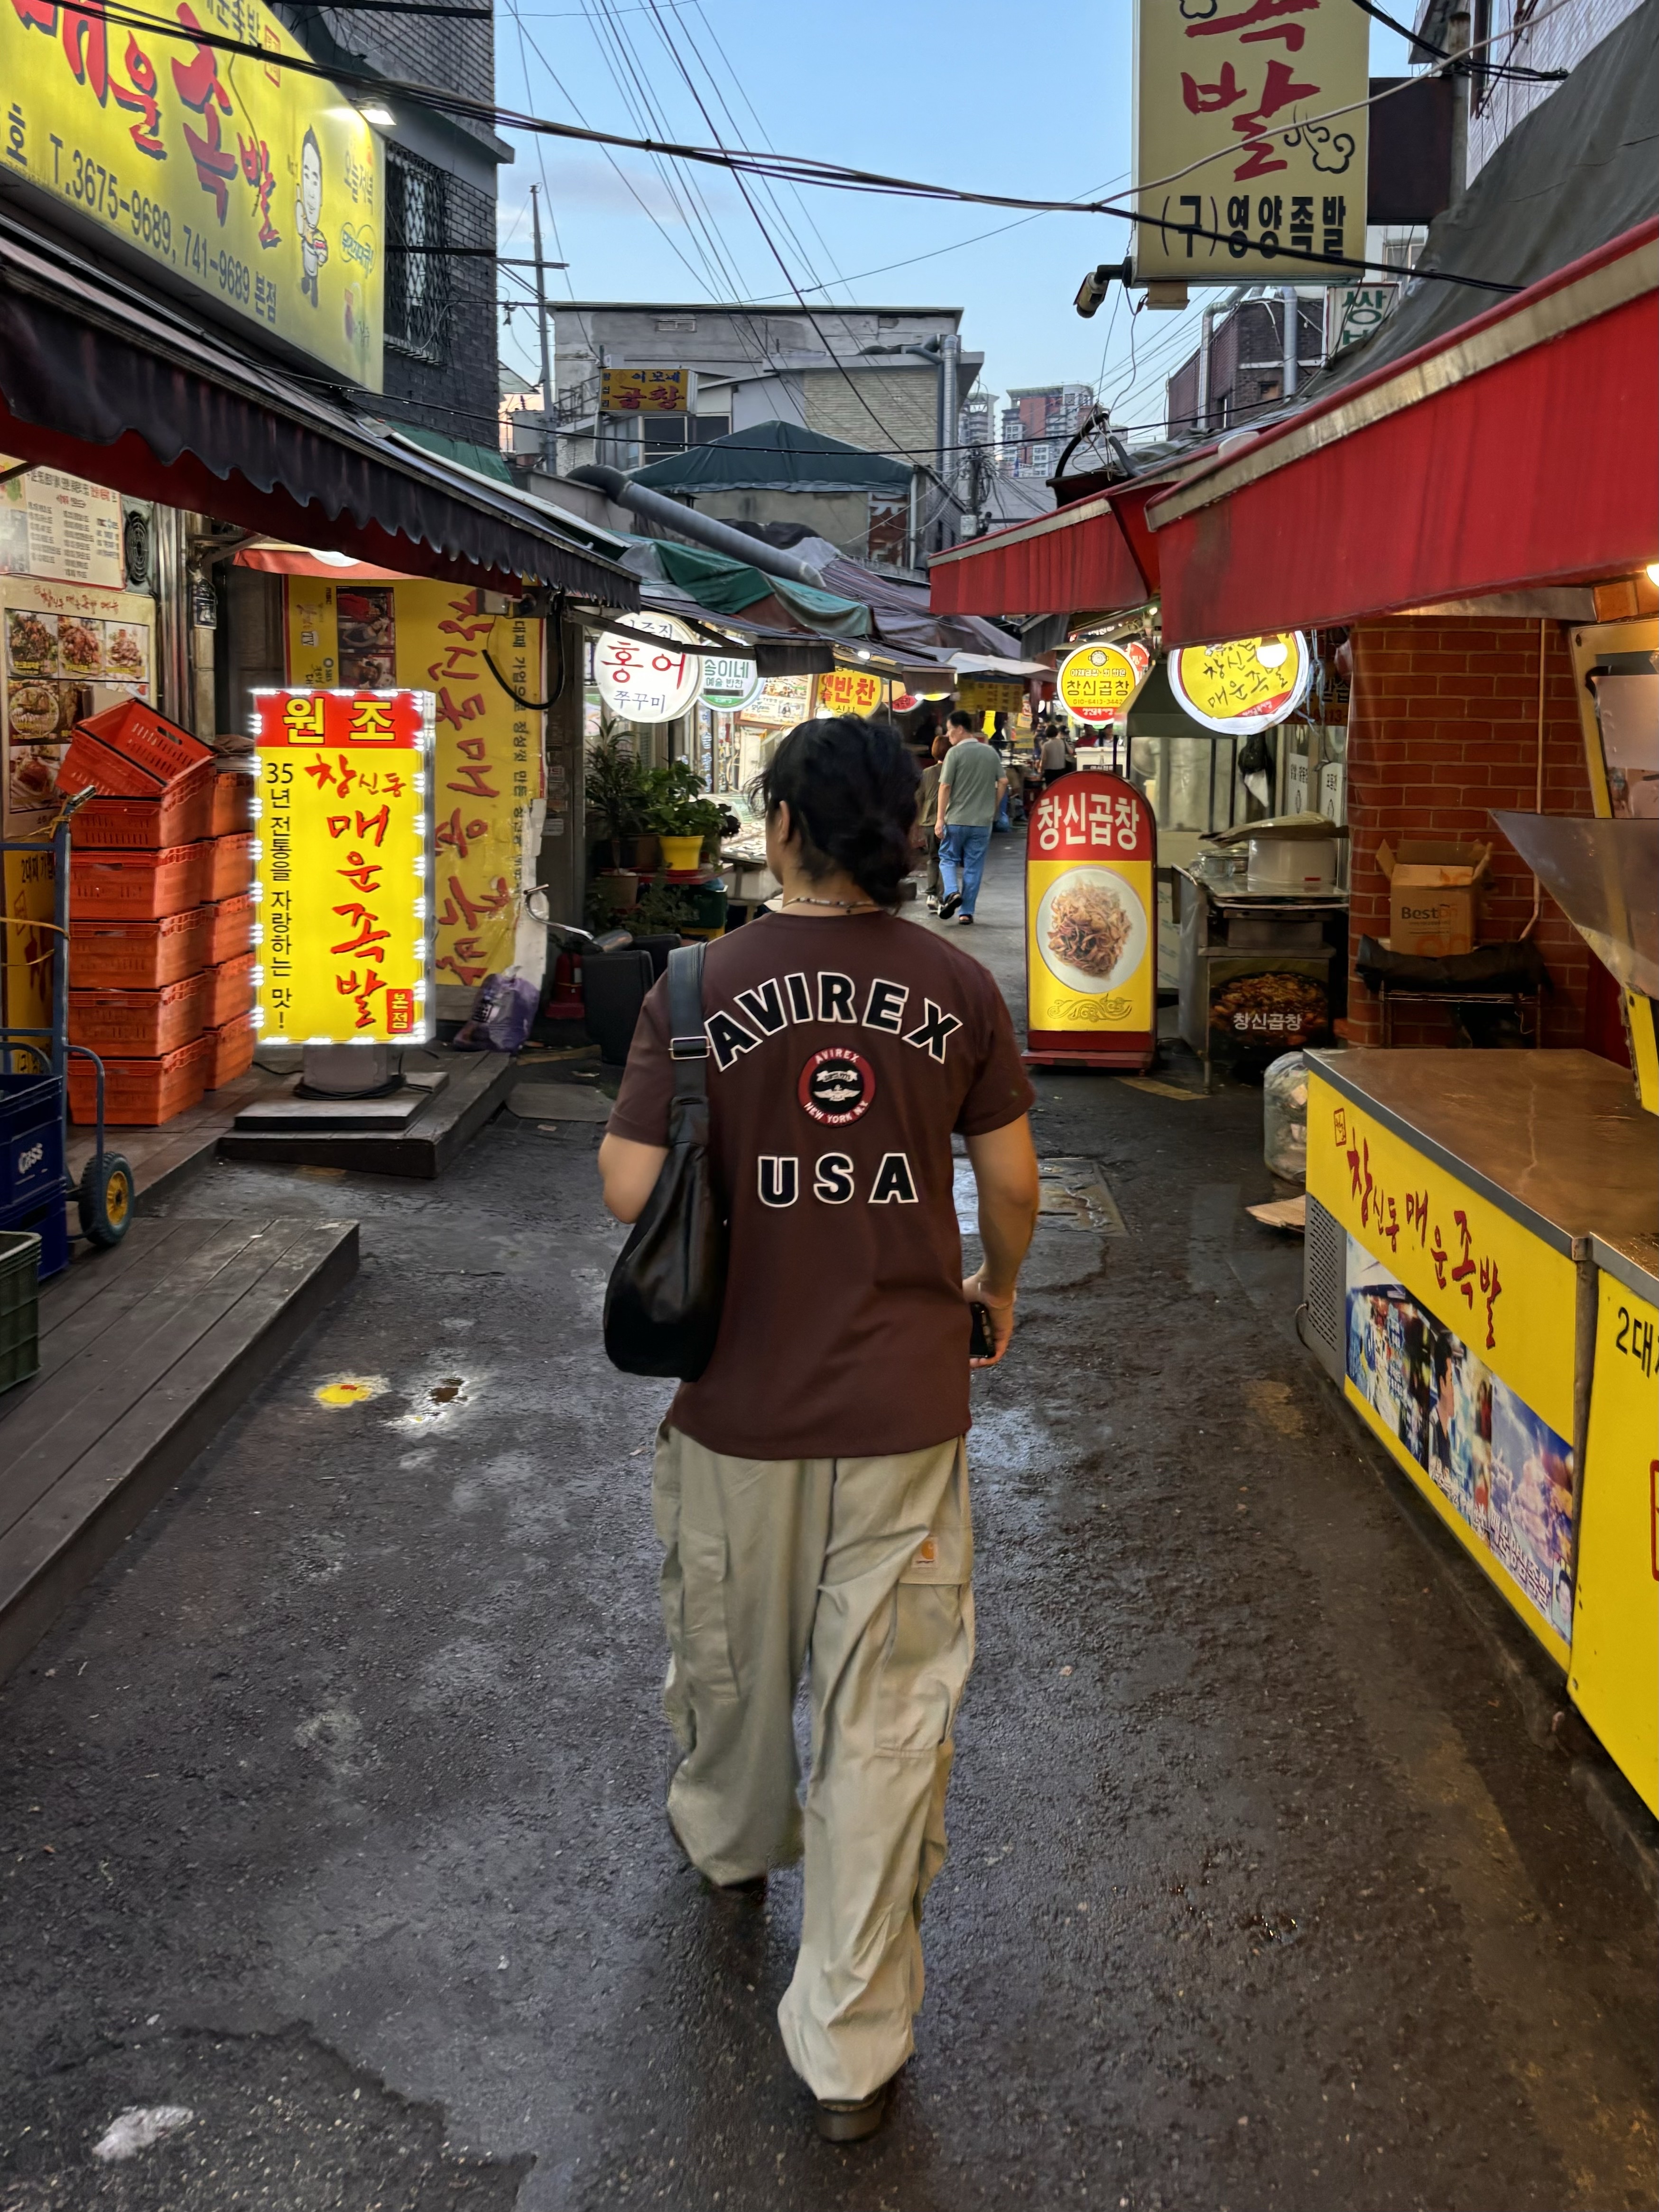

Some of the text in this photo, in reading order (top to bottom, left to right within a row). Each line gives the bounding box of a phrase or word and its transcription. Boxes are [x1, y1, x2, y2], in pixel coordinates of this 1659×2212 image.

[182, 225, 250, 305] 741-9689
[254, 270, 278, 324] 본점
[601, 640, 686, 690] 홍어
[704, 659, 749, 679] 송이네
[706, 677, 743, 688] 예술 반찬
[1066, 680, 1130, 696] 창신곱창
[613, 690, 666, 714] 쭈꾸미
[834, 676, 875, 706] 반찬
[283, 696, 397, 745] 원조
[304, 752, 407, 799] 창신동
[1037, 792, 1140, 851] 창신곱창
[269, 816, 293, 881] 전통을
[269, 889, 293, 977] 자랑하는
[271, 988, 292, 1029] 맛!
[393, 991, 409, 1030] 본점
[703, 971, 964, 1073] AVIREX
[1233, 1013, 1302, 1031] 창신곱창
[815, 1048, 860, 1064] AVIREX
[803, 1101, 825, 1120] NEW
[827, 1112, 853, 1124] YORK
[758, 1152, 919, 1208] USA
[1347, 1127, 1400, 1254] 창신동
[1615, 1306, 1659, 1379] 2대
